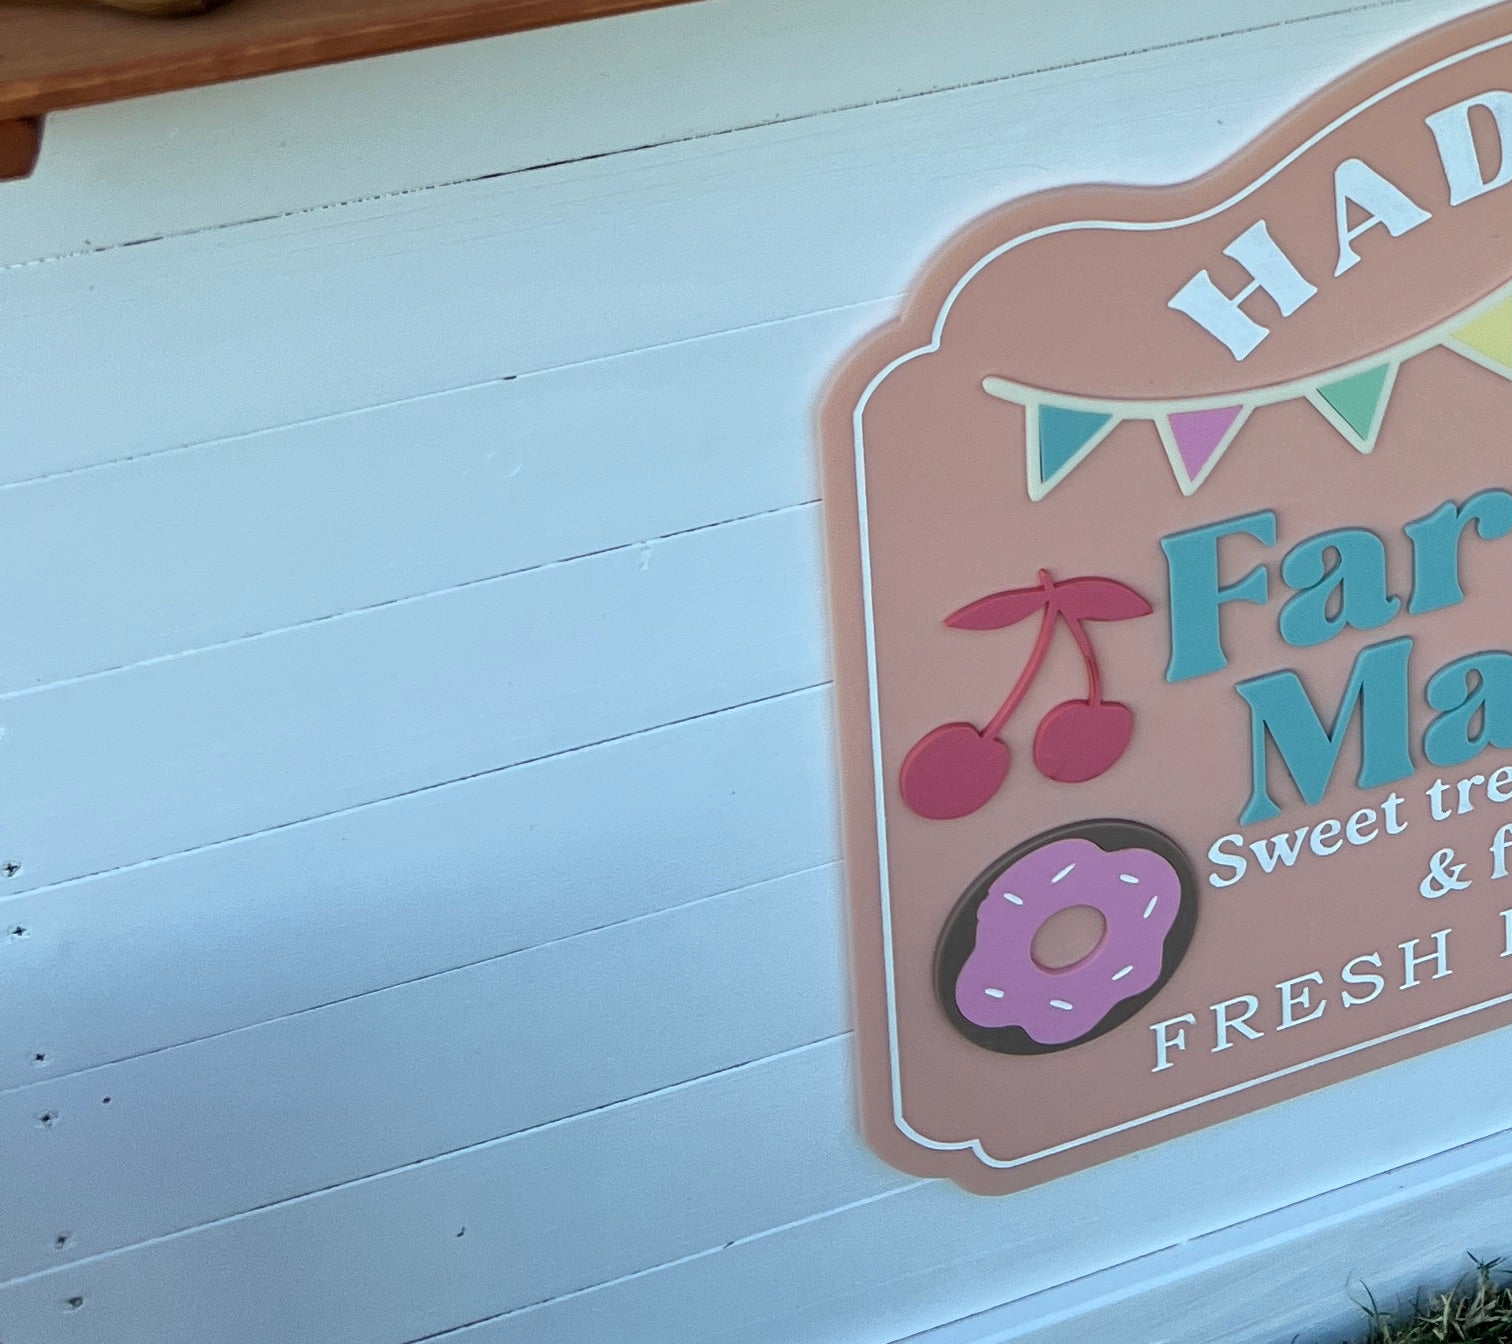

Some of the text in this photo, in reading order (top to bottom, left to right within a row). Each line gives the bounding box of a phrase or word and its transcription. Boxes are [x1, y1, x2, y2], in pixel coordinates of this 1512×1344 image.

[1207, 794, 1407, 889] Sweet
[1417, 846, 1473, 899] &
[1149, 928, 1454, 1072] FRESH
